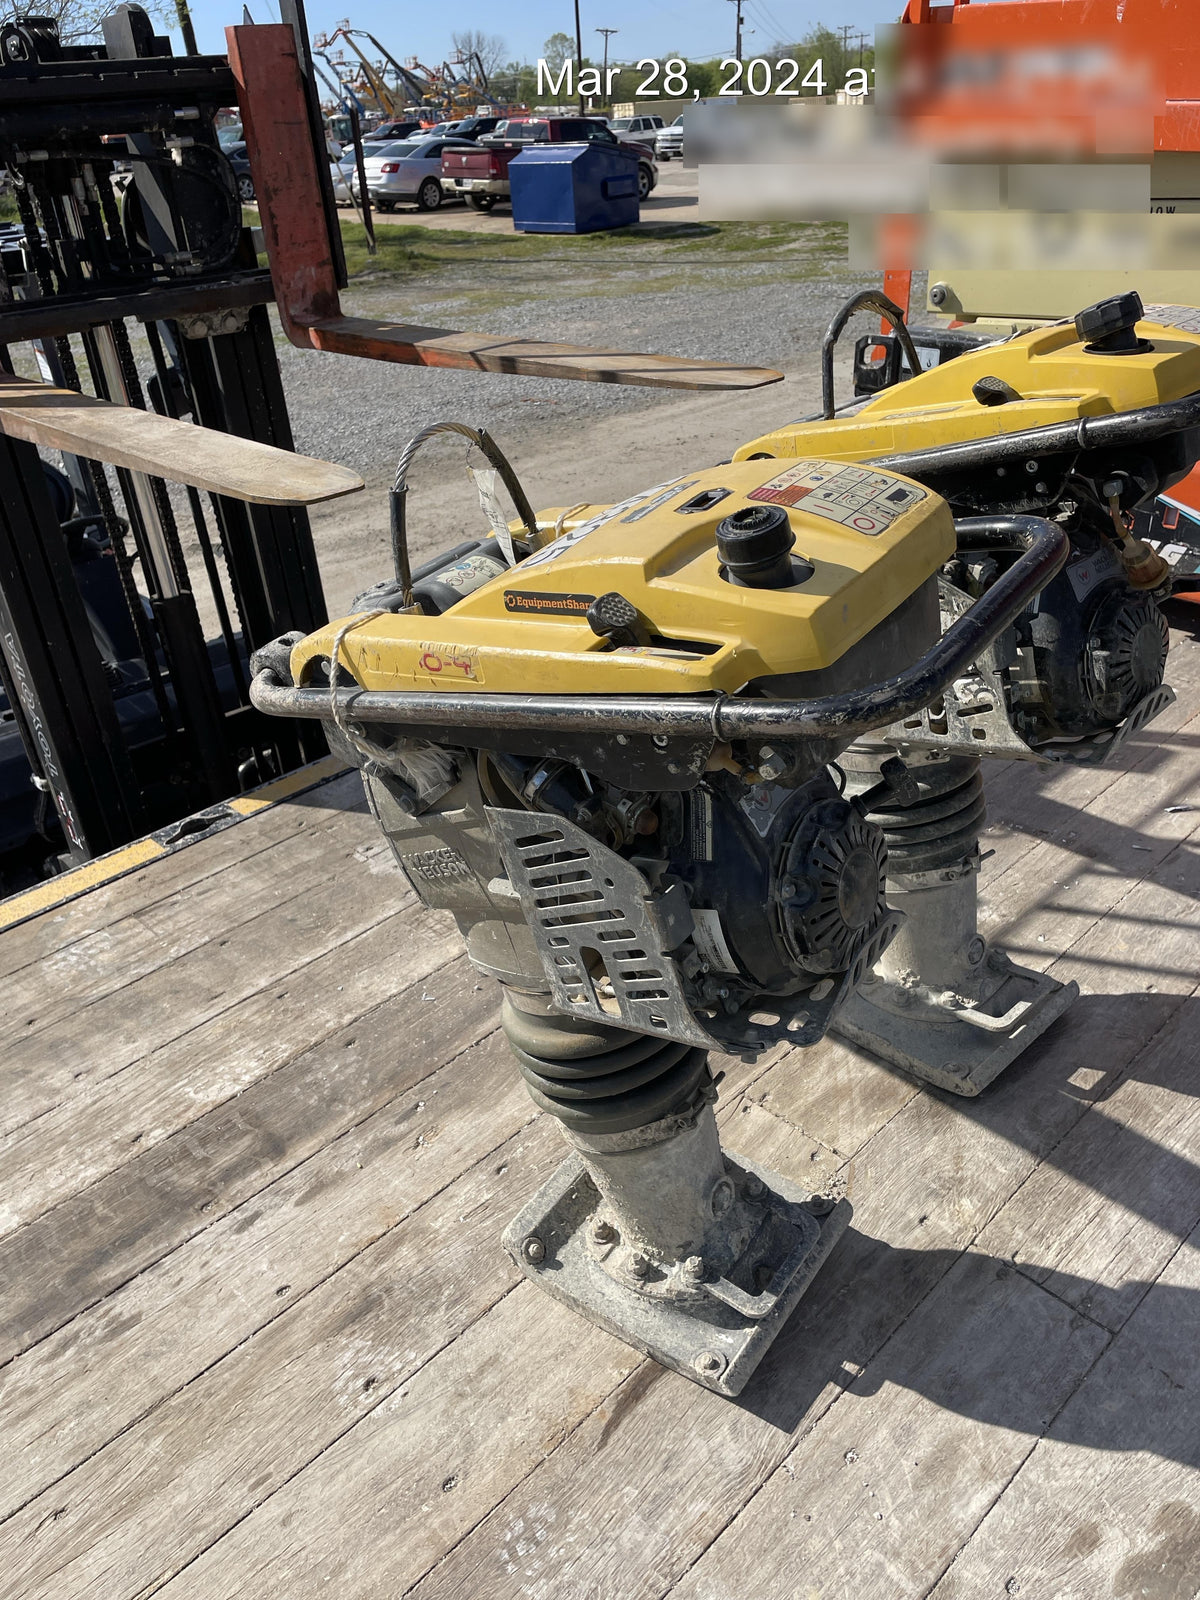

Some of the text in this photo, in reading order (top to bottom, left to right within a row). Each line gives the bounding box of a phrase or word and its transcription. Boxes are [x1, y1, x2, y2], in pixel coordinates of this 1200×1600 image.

[1150, 206, 1176, 214] OW
[516, 596, 593, 610] EquipmentShar
[4, 632, 59, 777] TOYOTA
[402, 847, 464, 867] WACKER
[412, 861, 472, 880] NEUSON
